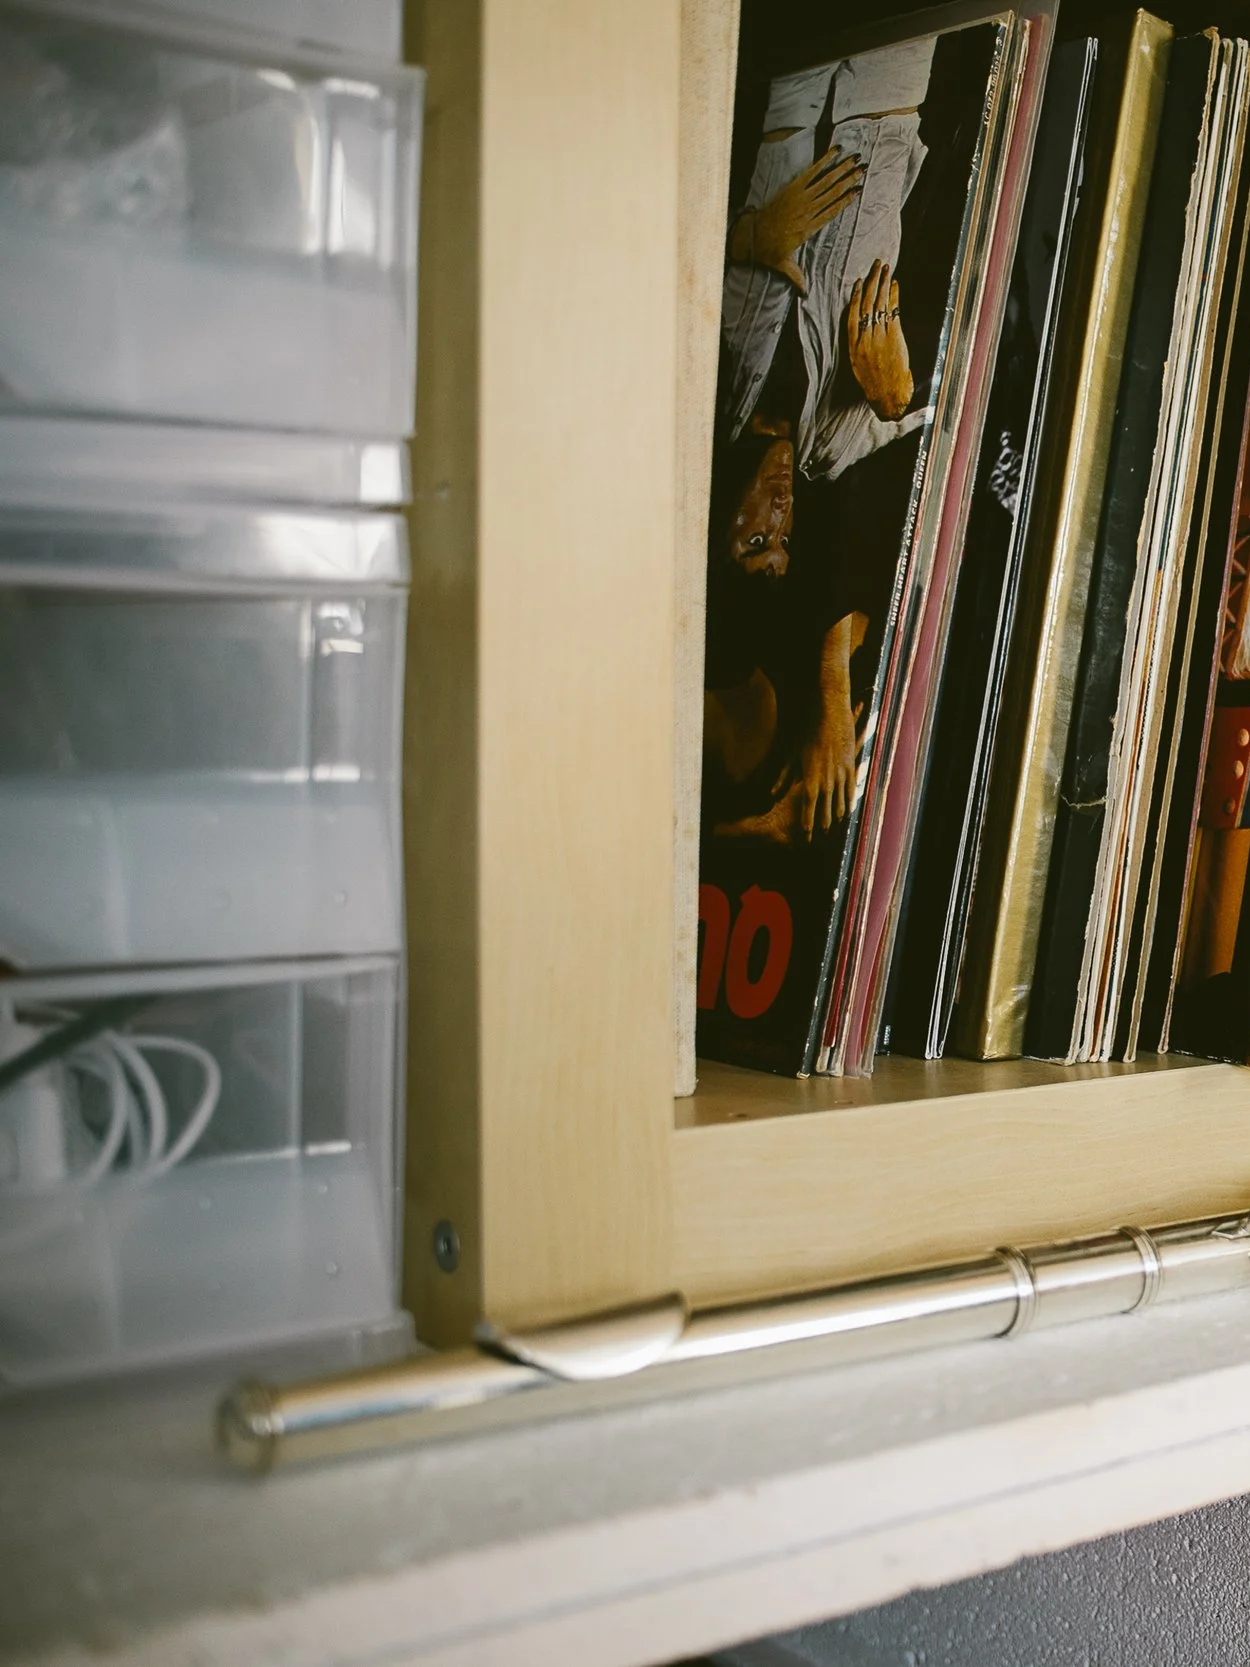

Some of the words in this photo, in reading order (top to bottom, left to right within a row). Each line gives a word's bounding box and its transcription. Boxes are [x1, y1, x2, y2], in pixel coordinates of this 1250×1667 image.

[897, 551, 909, 588] HEART
[906, 499, 919, 547] ATTACK
[916, 450, 927, 489] QUEEN
